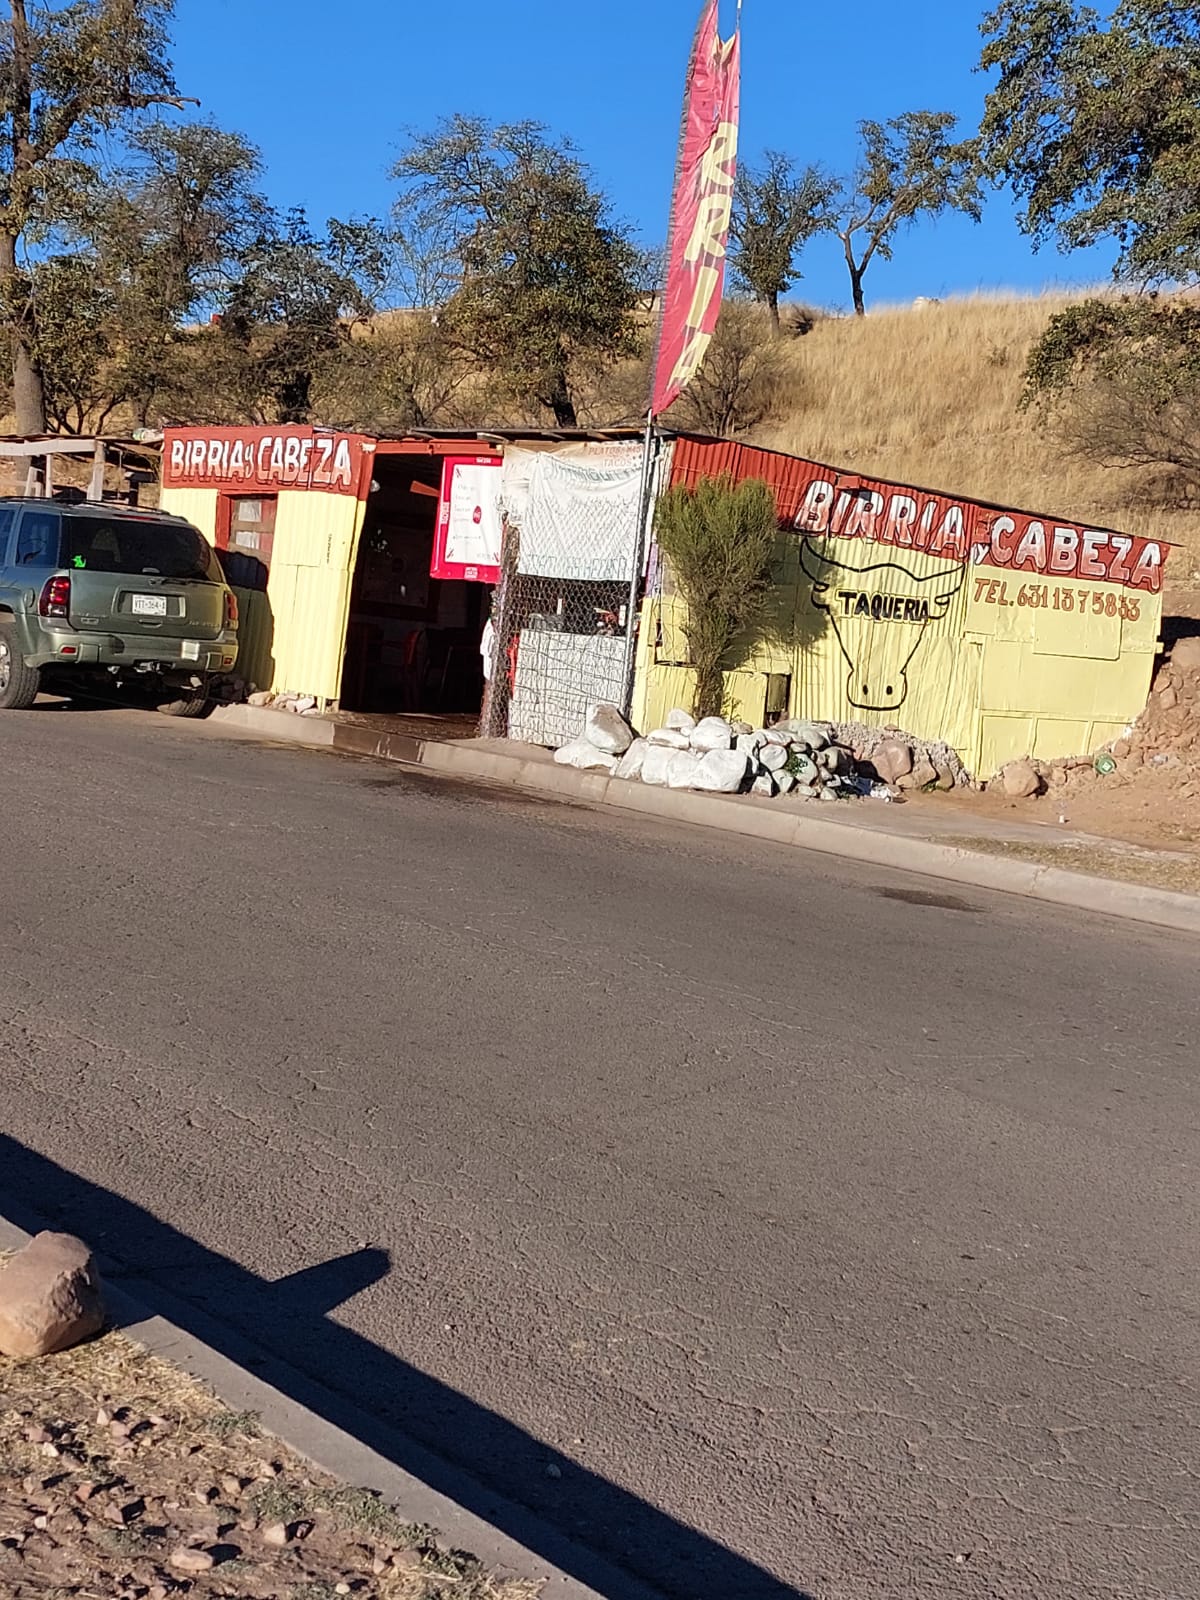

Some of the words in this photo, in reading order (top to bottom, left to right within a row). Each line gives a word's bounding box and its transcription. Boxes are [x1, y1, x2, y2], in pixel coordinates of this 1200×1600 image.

[170, 439, 244, 482] BIRRIA
[257, 437, 351, 488] CABEZA
[793, 480, 967, 559] BIRRIA
[991, 515, 1162, 594] CABEZA
[838, 591, 929, 621] TAQUERIA
[973, 578, 1014, 607] TEL.
